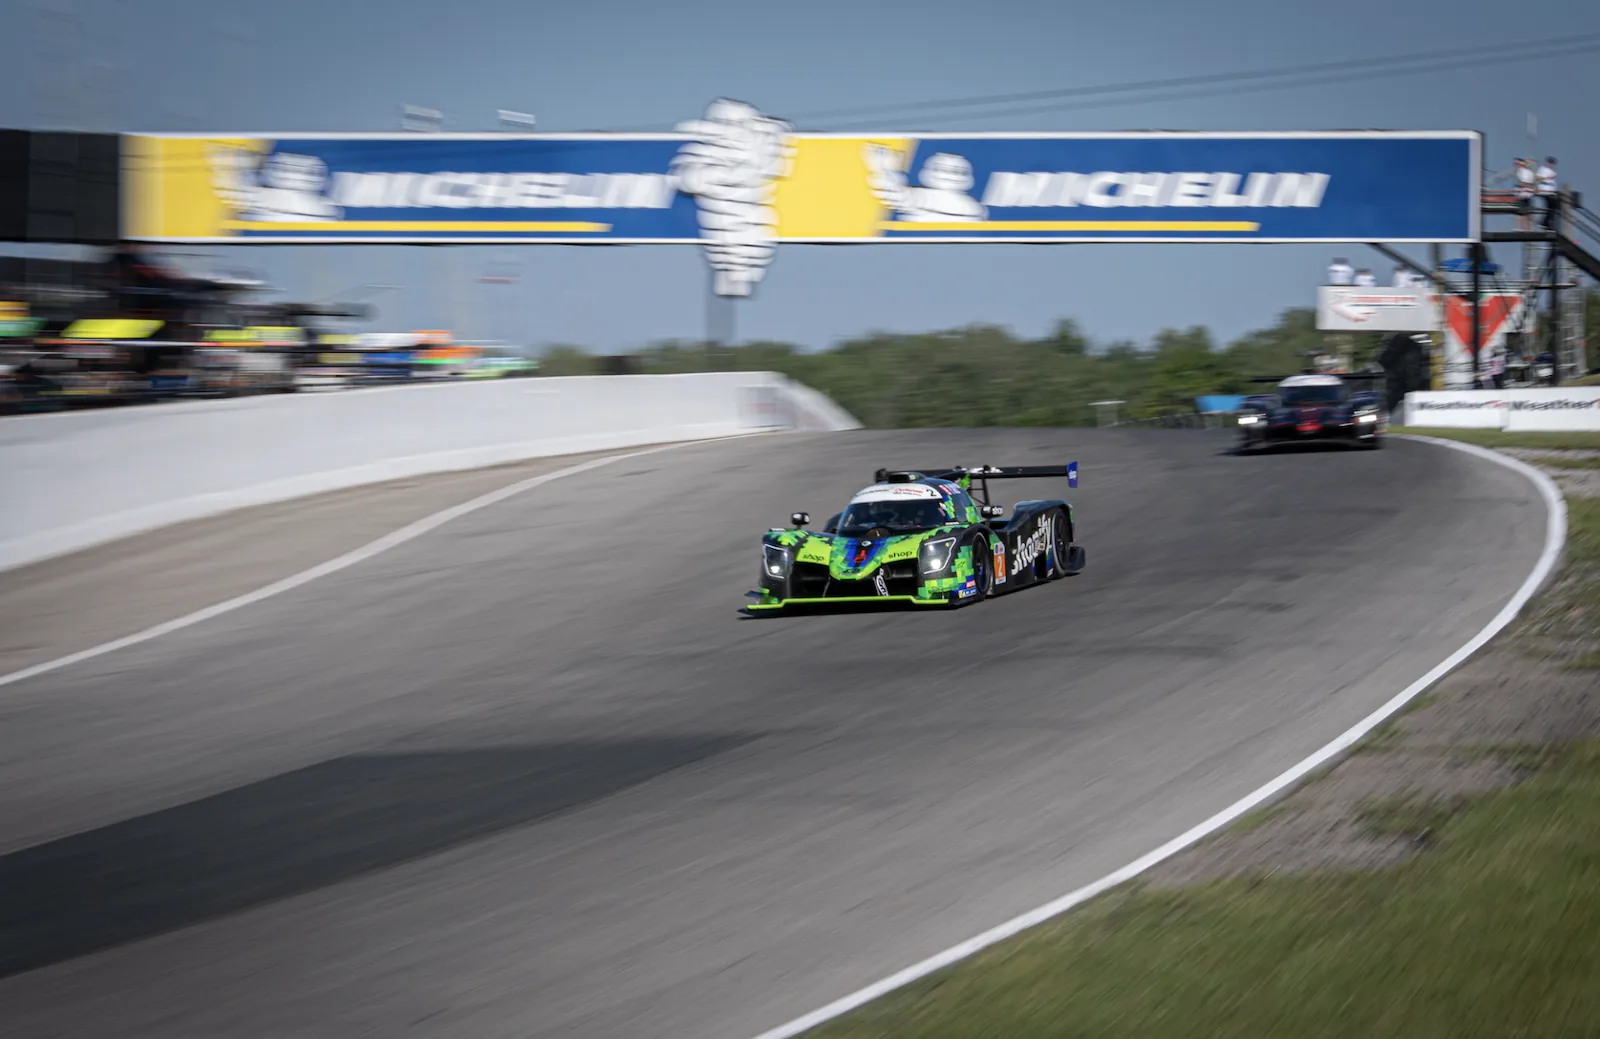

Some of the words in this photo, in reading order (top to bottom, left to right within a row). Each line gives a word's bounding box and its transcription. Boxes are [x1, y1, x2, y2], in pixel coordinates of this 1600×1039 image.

[331, 172, 677, 208] MICHELIN
[981, 171, 1331, 207] MICHELIN
[926, 488, 937, 497] 2
[802, 554, 825, 563] shop
[888, 550, 913, 560] shop
[997, 555, 1004, 577] 2
